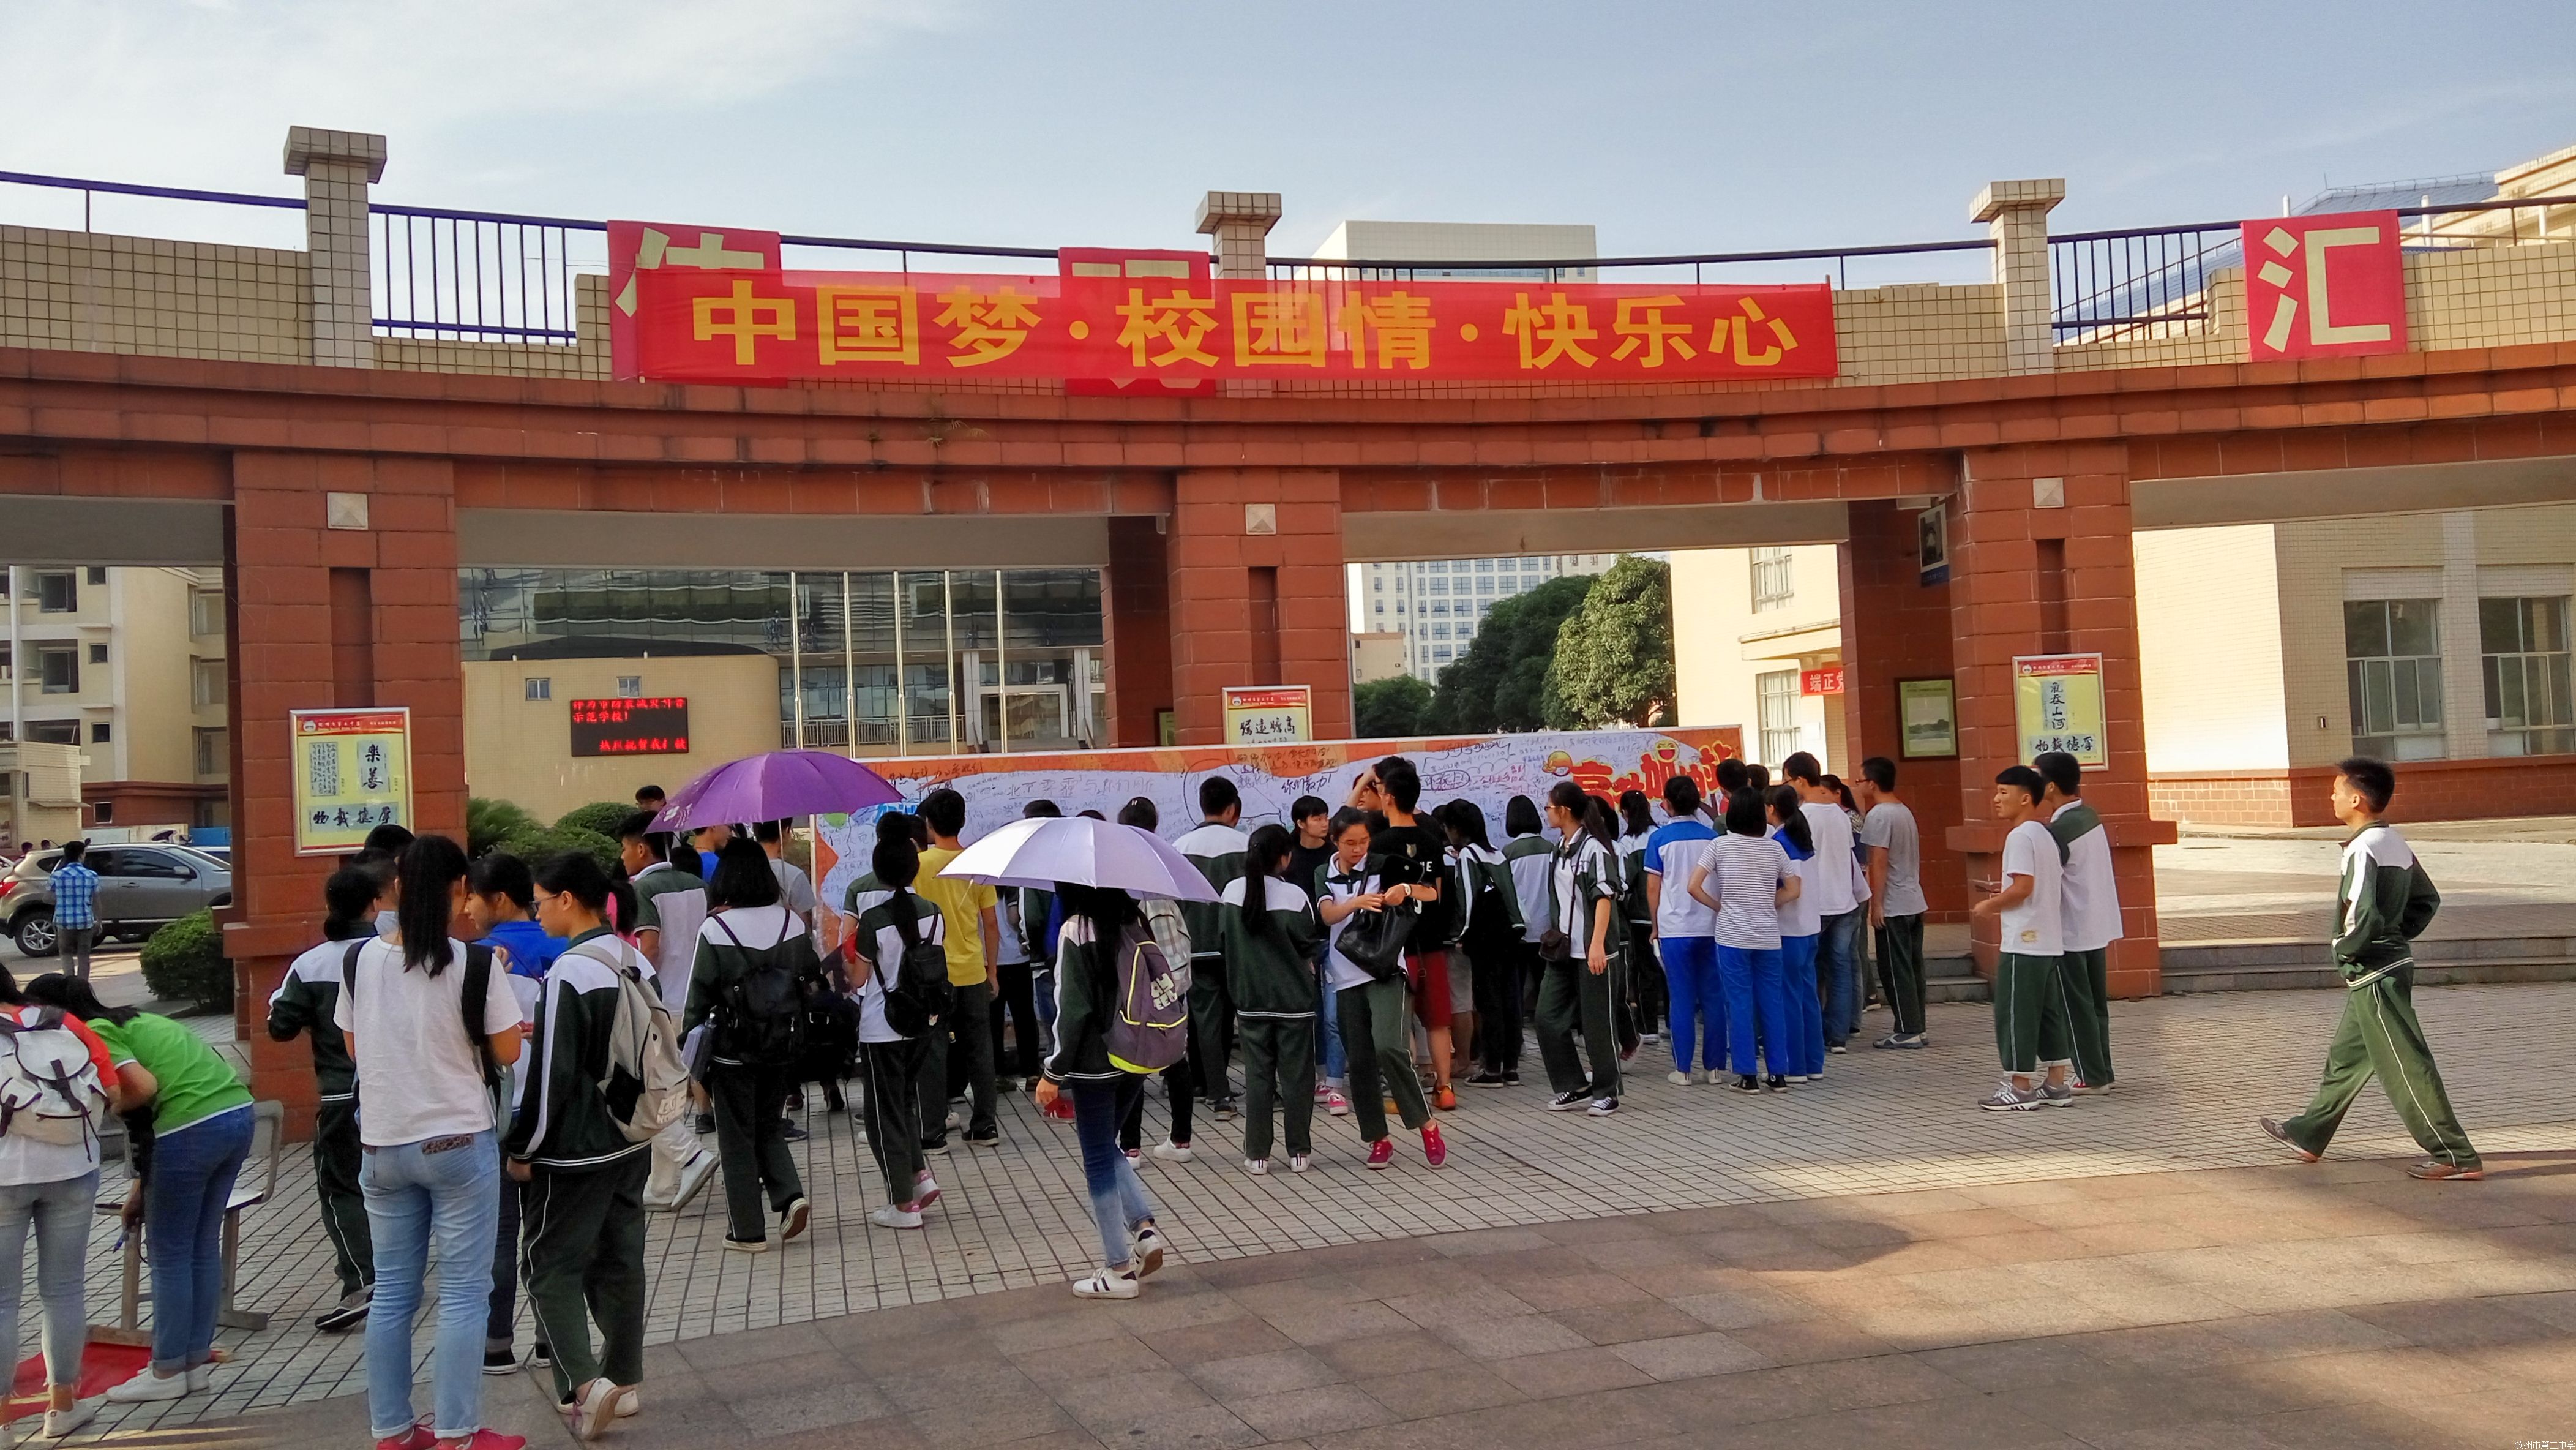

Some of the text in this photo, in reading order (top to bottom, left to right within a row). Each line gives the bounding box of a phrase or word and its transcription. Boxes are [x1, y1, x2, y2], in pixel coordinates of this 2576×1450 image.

[692, 280, 1799, 369] 中国梦·校园情·快乐心
[2257, 226, 2391, 353] 汇
